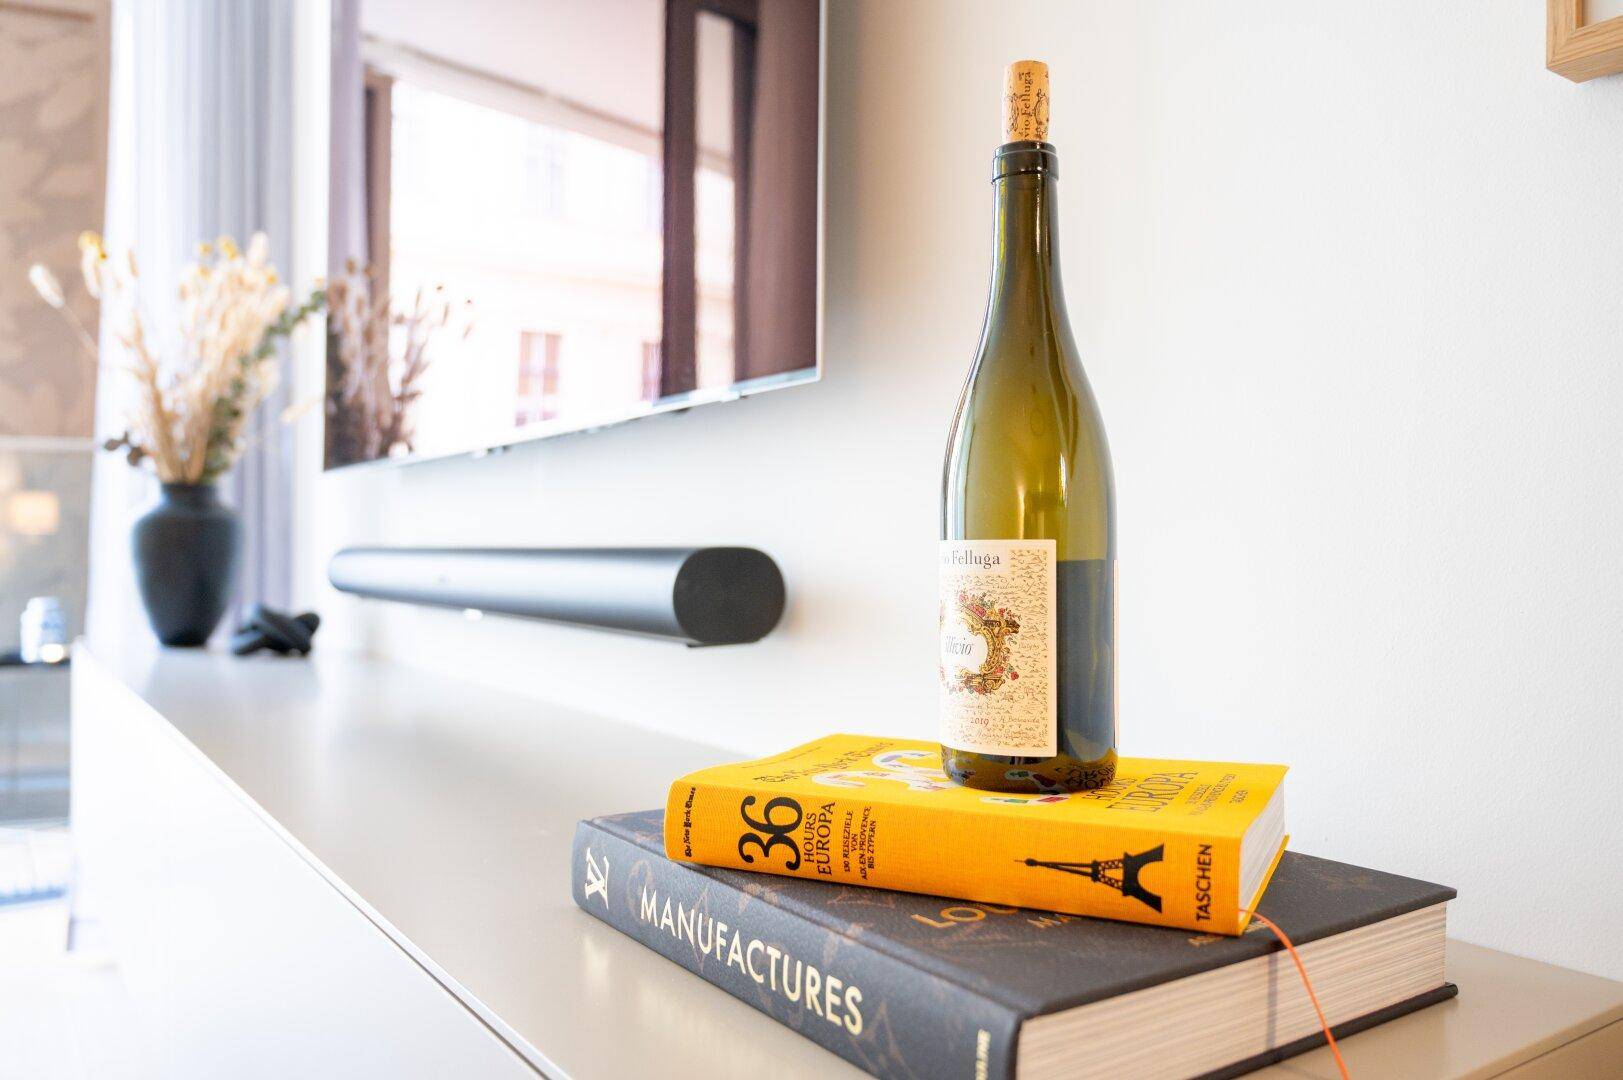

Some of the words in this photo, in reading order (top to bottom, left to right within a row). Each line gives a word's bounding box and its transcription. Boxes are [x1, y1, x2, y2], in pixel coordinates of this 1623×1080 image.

[1019, 71, 1034, 117] Felluga
[951, 549, 1001, 570] Felluga
[970, 717, 990, 727] 2019
[684, 786, 697, 809] Times
[1105, 771, 1199, 813] EUROPA
[683, 809, 692, 828] York
[737, 795, 803, 871] 36
[842, 809, 854, 859] REISEZIELE
[683, 828, 691, 845] New
[684, 844, 692, 858] The
[803, 812, 817, 863] HOURS
[816, 802, 836, 876] EUROPA
[850, 833, 858, 852] VON
[867, 820, 877, 855] ZYPERN
[867, 856, 875, 870] BIS
[1195, 843, 1213, 923] TASCHEN
[640, 884, 864, 1036] MANUFACTURES
